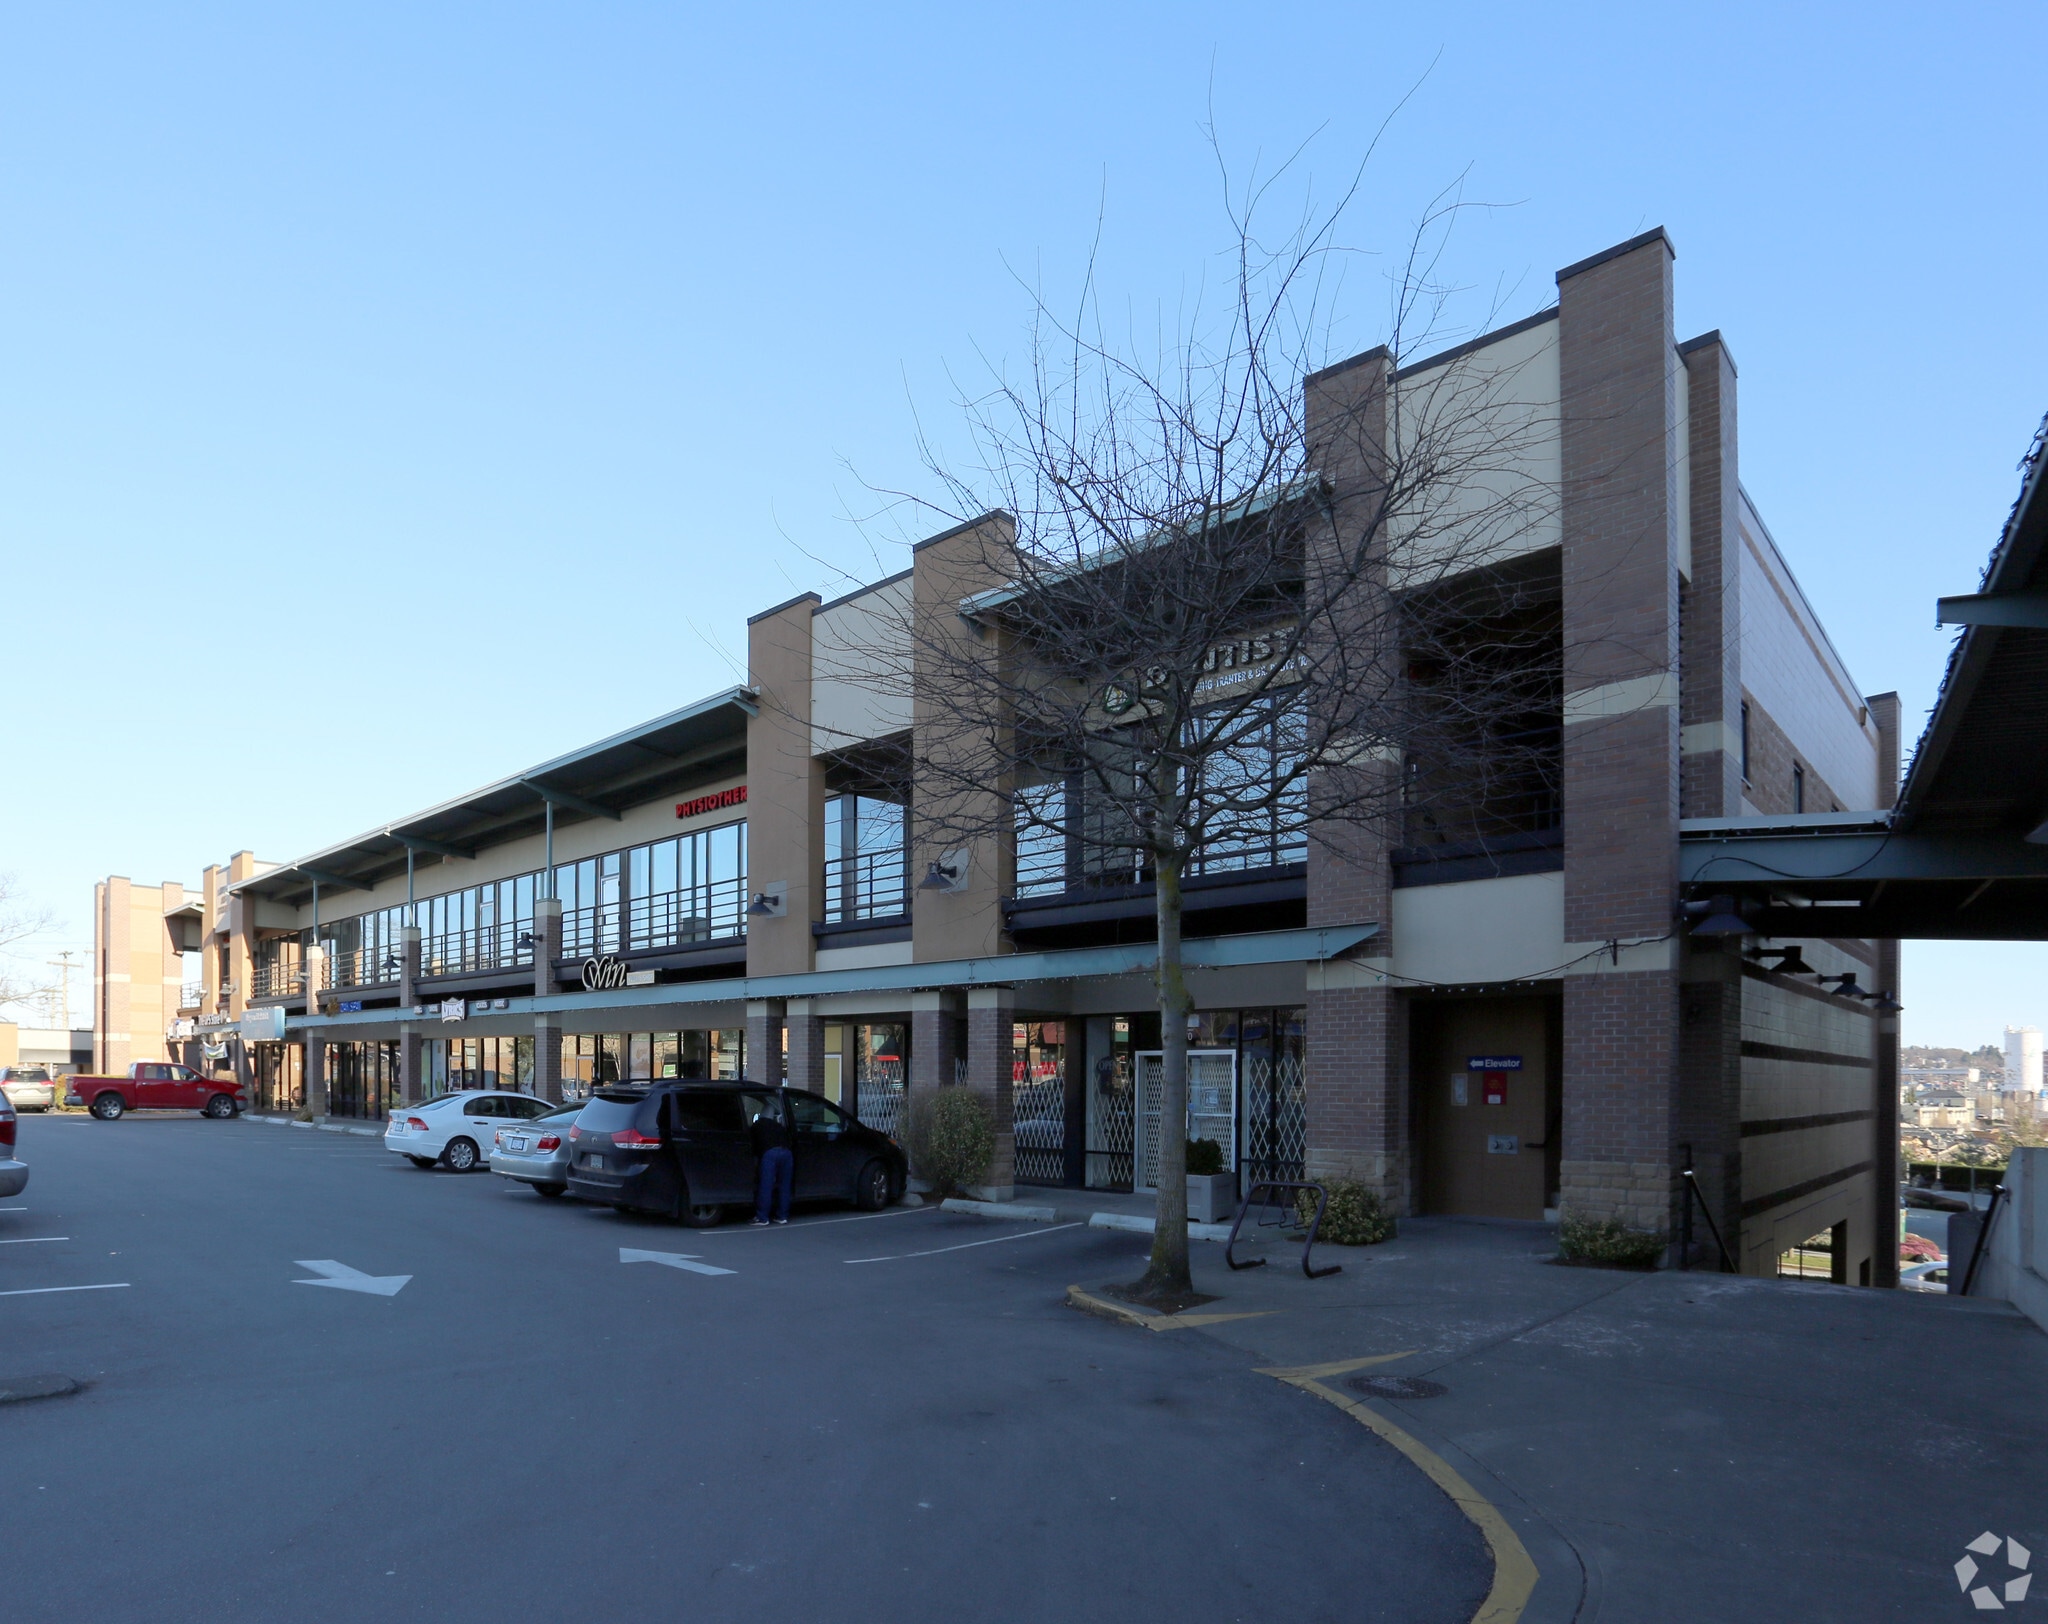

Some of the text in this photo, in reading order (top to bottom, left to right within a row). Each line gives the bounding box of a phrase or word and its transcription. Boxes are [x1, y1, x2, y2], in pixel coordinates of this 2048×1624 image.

[1247, 669, 1254, 680] &
[676, 785, 747, 819] PHYSIOTHER
[582, 956, 626, 989] Win
[1484, 1059, 1520, 1068] Elevator
